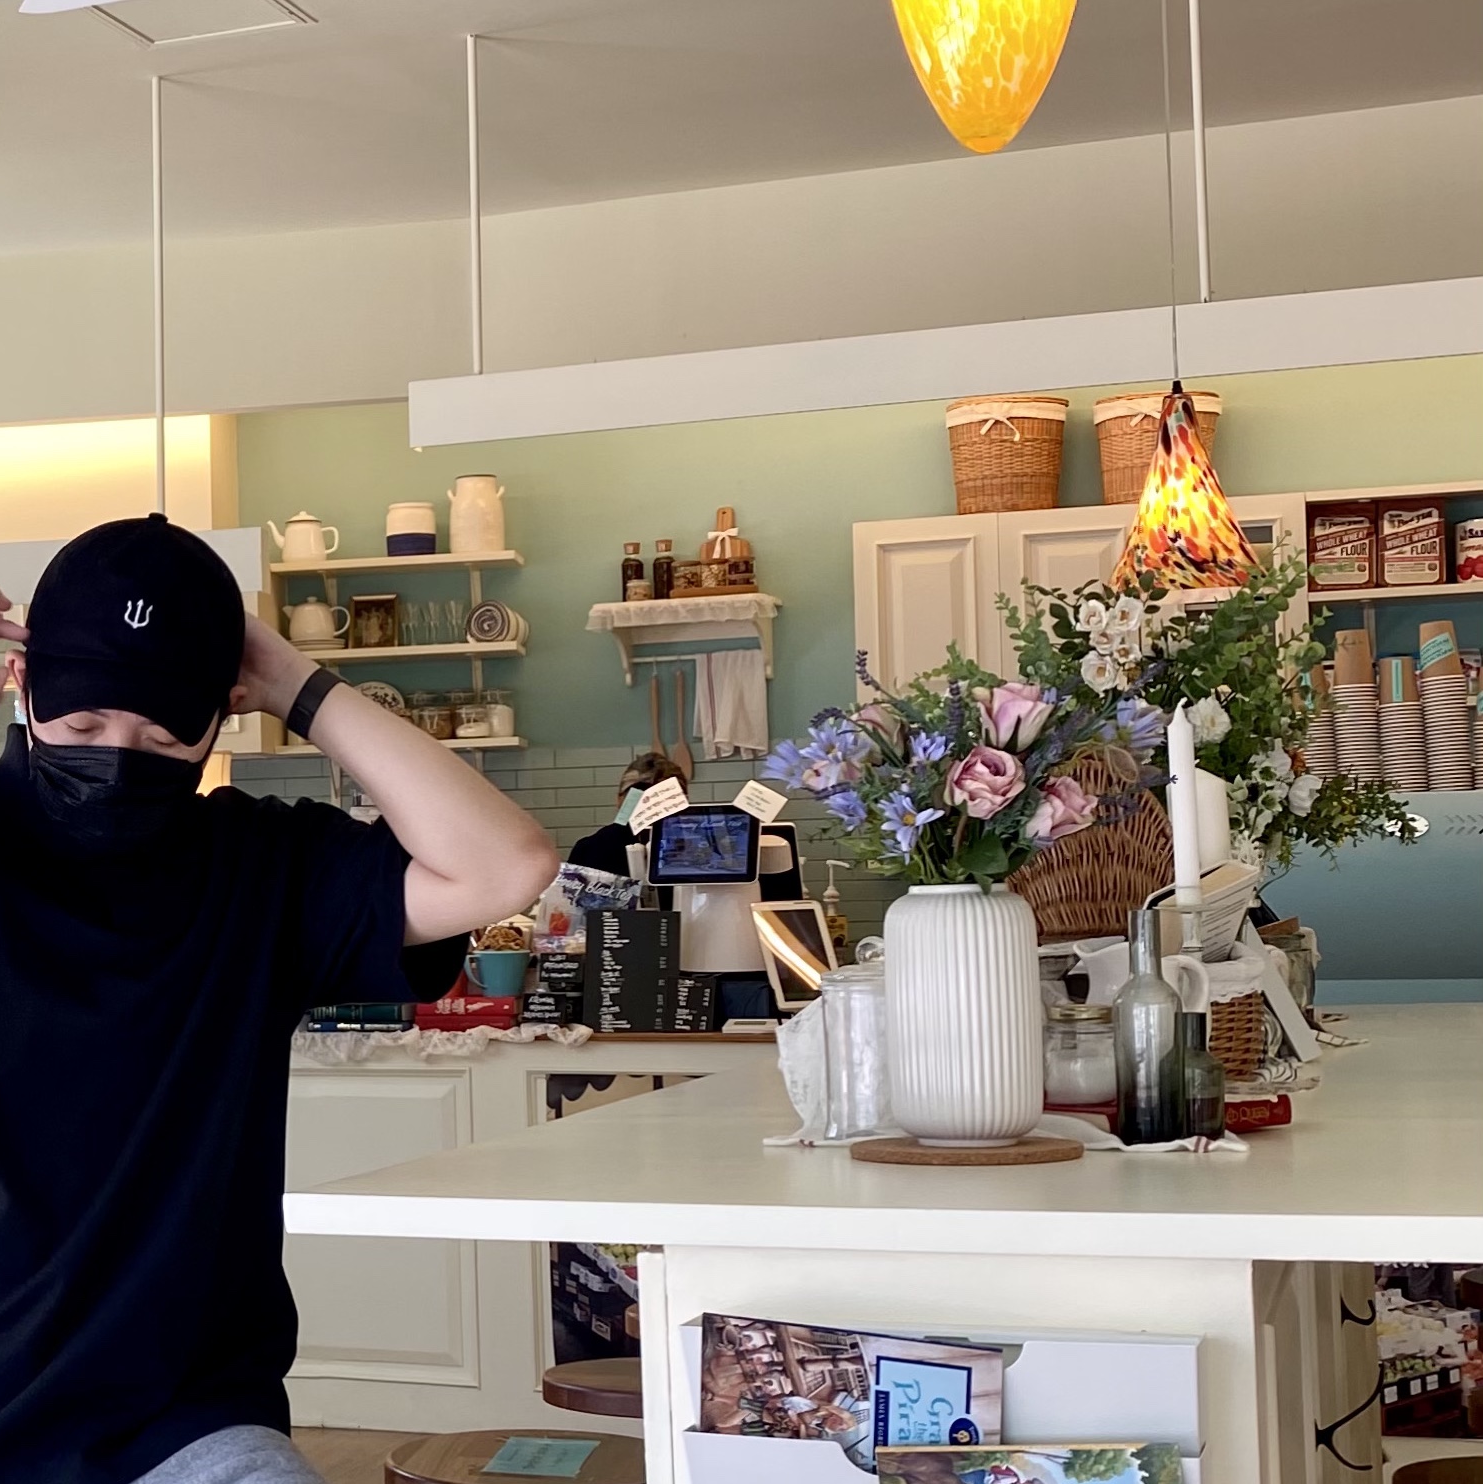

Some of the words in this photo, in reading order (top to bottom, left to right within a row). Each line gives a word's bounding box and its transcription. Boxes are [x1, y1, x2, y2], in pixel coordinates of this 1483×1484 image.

[1316, 536, 1341, 551] WHOLE
[1342, 530, 1368, 544] WHEAT
[1385, 533, 1411, 549] WHOLE
[1411, 527, 1438, 542] WHEAT
[1340, 541, 1368, 557] FLOUR
[1410, 541, 1438, 556] FLOUR
